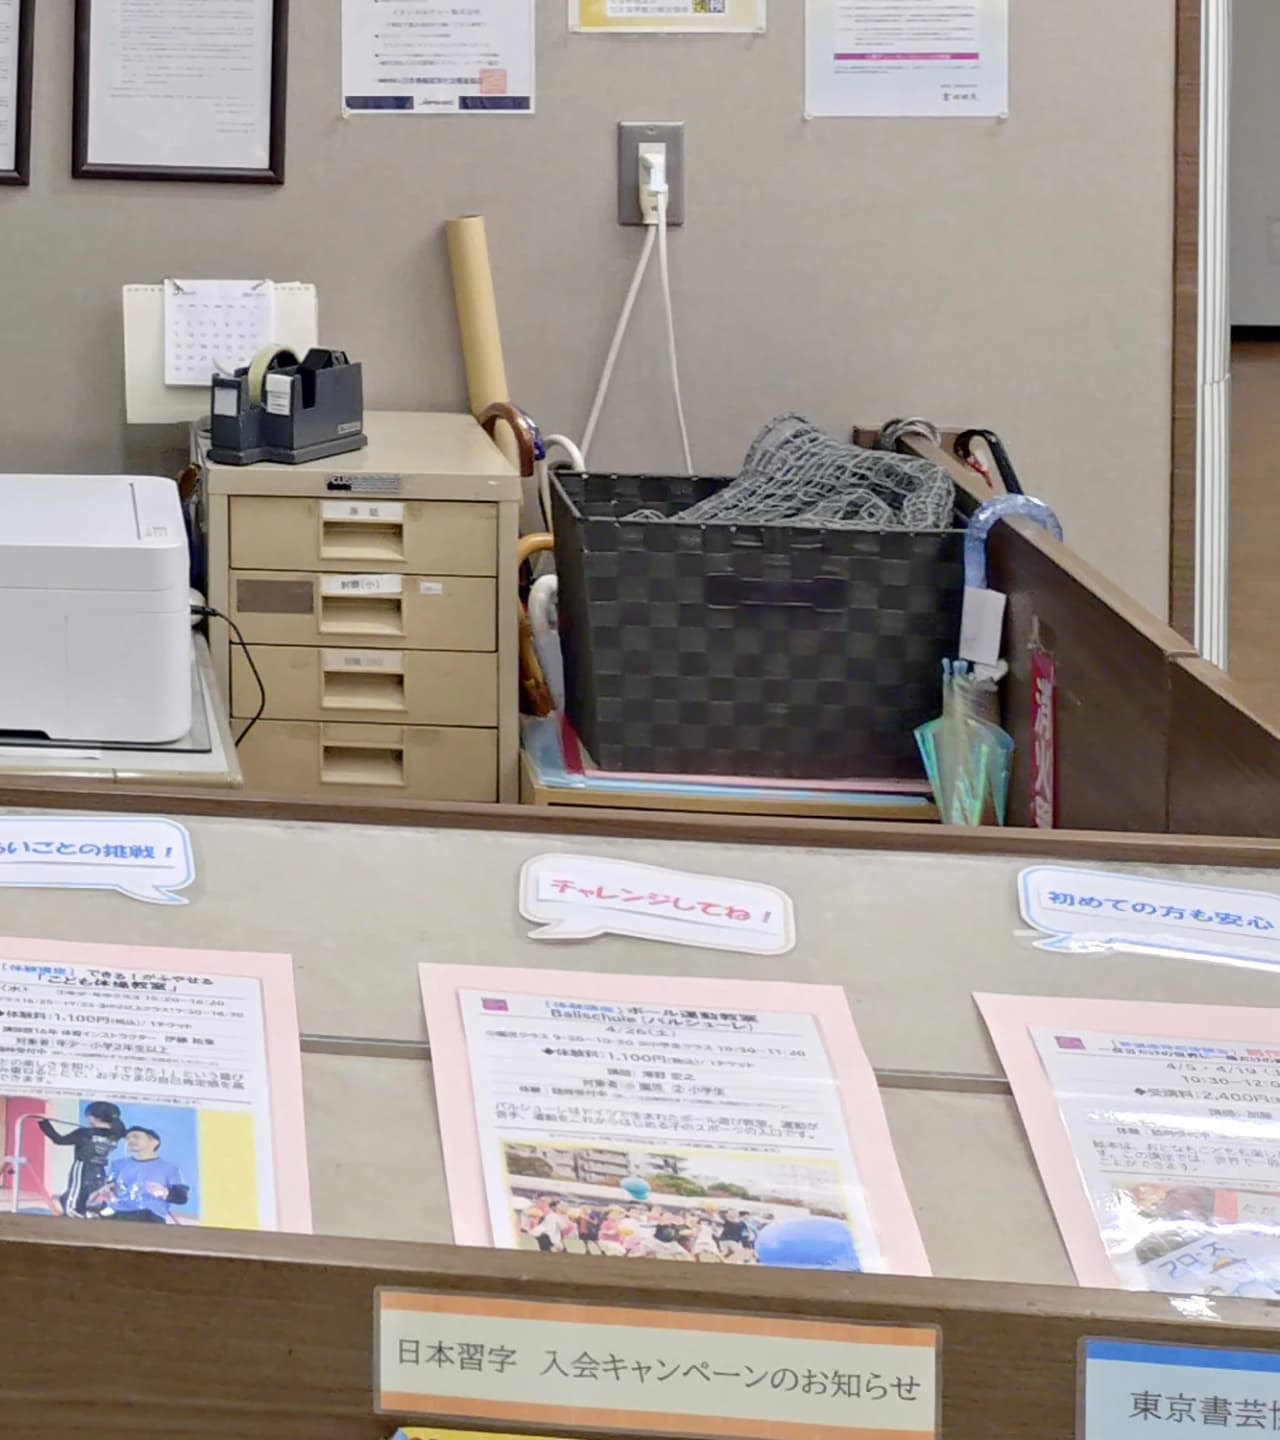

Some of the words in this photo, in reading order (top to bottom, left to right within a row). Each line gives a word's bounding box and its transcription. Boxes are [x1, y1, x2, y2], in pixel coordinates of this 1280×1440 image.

[550, 878, 773, 926] チャレンジしてね！
[1048, 887, 1276, 932] 初めての方も安心
[397, 1338, 519, 1372] 日本習字
[540, 1349, 922, 1402] 入会キャンペーンのお知らせ
